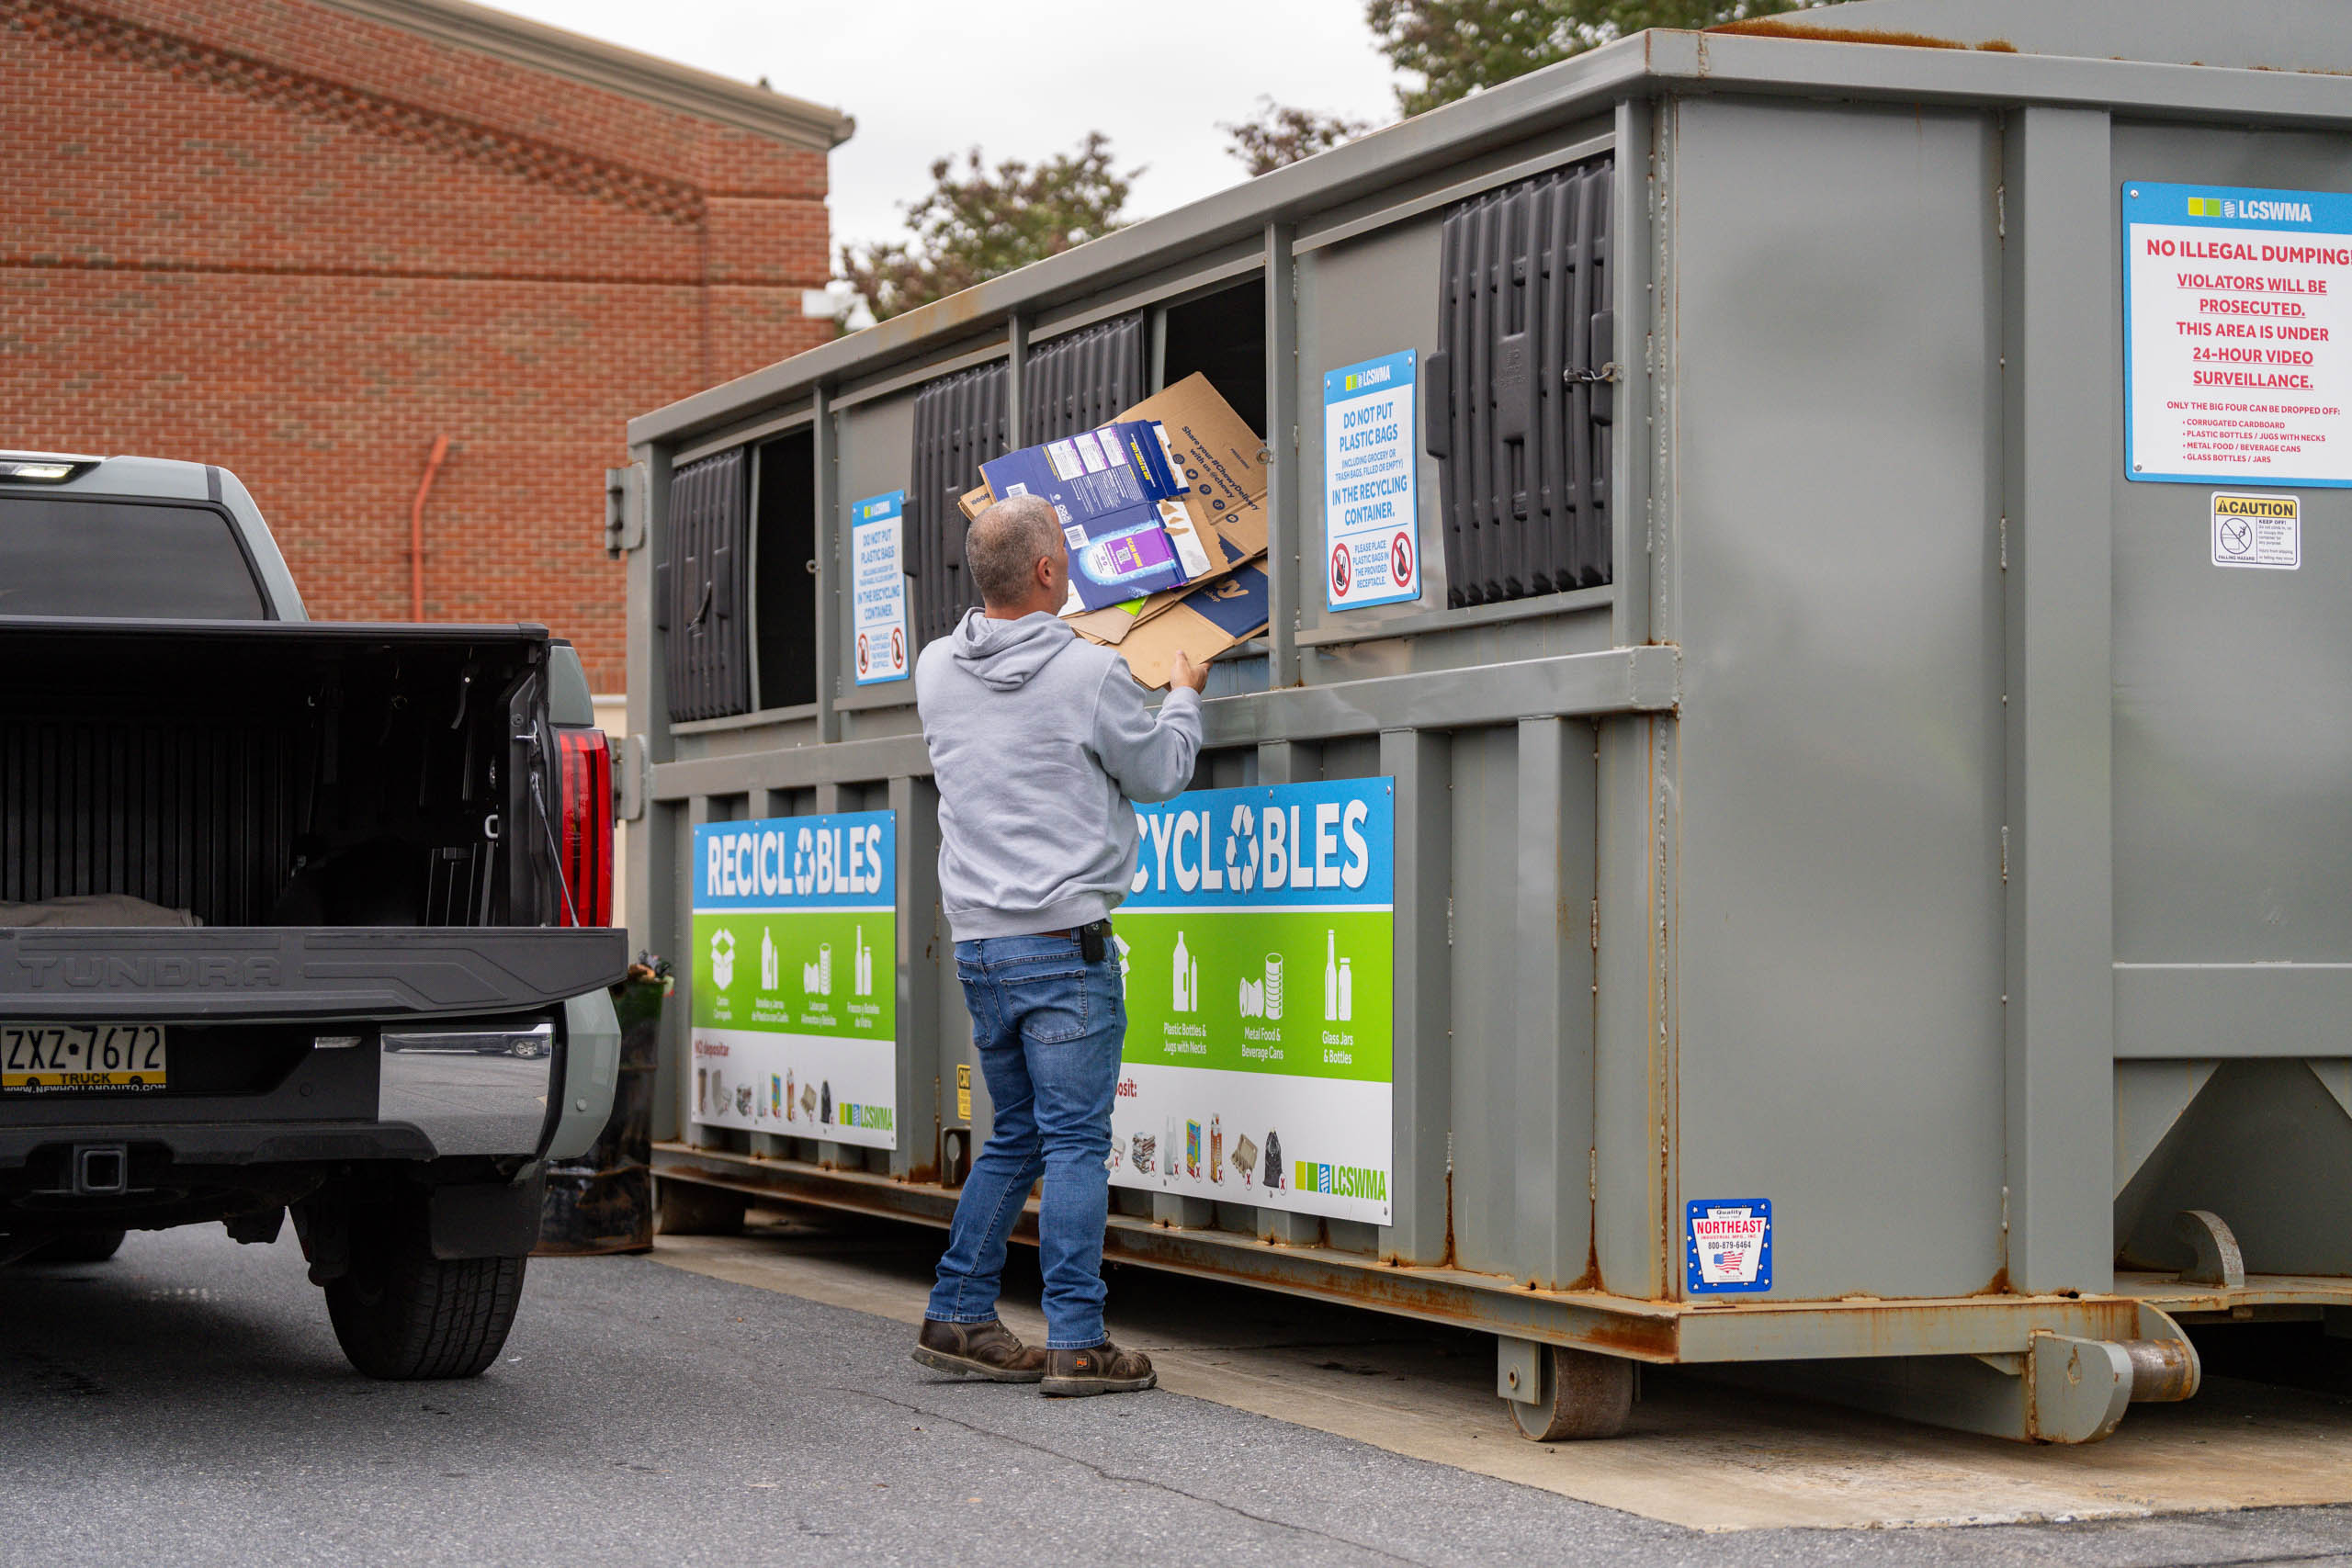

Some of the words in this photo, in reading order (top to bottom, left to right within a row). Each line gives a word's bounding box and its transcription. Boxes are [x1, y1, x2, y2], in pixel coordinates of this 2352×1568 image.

[2239, 200, 2312, 222] LCSWMA
[2147, 239, 2176, 257] NO
[2180, 241, 2257, 261] ILLEGAL
[2177, 273, 2264, 290] VIOLATORS
[2267, 277, 2304, 292] WILL
[2308, 279, 2327, 293] BE
[2199, 299, 2306, 316] PROSECUTED.
[2177, 321, 2212, 336] THIS
[2215, 323, 2256, 338] AREA
[2260, 325, 2274, 339] IS
[2277, 327, 2329, 342] UNDER
[2193, 347, 2262, 363] 24-HOUR
[2266, 350, 2313, 365] VIDEO
[1363, 366, 1391, 387] LCSWMA
[2193, 370, 2313, 389] SURVEILLANCE.
[1343, 411, 1356, 429] DO
[1357, 406, 1375, 426] NOT
[1376, 401, 1394, 421] PUT
[2166, 400, 2189, 410] ONLY
[2190, 402, 2208, 411] THE
[2209, 402, 2224, 412] BIG
[2225, 403, 2248, 412] FOUR
[2249, 404, 2267, 413] CAN
[2268, 405, 2280, 413] BE
[2281, 406, 2321, 415] DROPPED
[2322, 407, 2341, 416] OFF:
[2187, 419, 2237, 427] CORRUGATED
[2238, 420, 2286, 429] CARDBOARD
[1182, 425, 1200, 446] Share
[1196, 445, 1214, 460] your
[1340, 430, 1374, 453] PLASTIC
[1375, 423, 1398, 445] BAGS
[2187, 431, 2218, 439] PLASTIC
[2220, 432, 2253, 440] BOTTLES
[2258, 433, 2278, 441] JUGS
[2301, 434, 2326, 442] NECKS
[2187, 442, 2211, 450] METAL
[2212, 443, 2233, 451] FOOD
[2240, 444, 2279, 452] BEVERAGE
[2280, 445, 2301, 453] CANS
[1190, 448, 1204, 464] with
[1203, 463, 1211, 472] us
[1342, 455, 1367, 469] (INCLUDING
[1367, 449, 1388, 463] GROCERY
[1389, 448, 1396, 457] OR
[2212, 454, 2247, 462] BOTTLES
[2252, 455, 2271, 463] JARS
[1335, 471, 1351, 481] TRASH
[1363, 464, 1378, 476] FILLED
[1379, 463, 1385, 472] OR
[1332, 488, 1341, 506] IN
[1342, 485, 1358, 502] THE
[1360, 475, 1408, 501] RECYCLING
[1345, 502, 1395, 526] CONTAINER.
[2229, 502, 2293, 515] CAUTION
[1355, 543, 1371, 553] PLEASE
[1372, 540, 1386, 551] PLACE
[1352, 554, 1371, 566] PLASTIC
[1372, 553, 1384, 562] BAGS
[1355, 568, 1363, 577] THE
[1364, 564, 1387, 575] PROVIDED
[17, 956, 280, 987] TUNDRA
[1163, 1021, 1182, 1036] Plastic
[1182, 1023, 1202, 1037] Bottles
[1202, 1024, 1206, 1037] &
[1244, 1026, 1261, 1041] Metal
[1261, 1028, 1275, 1041] Food
[1276, 1028, 1281, 1042] &
[1163, 1040, 1177, 1055] Jugs
[1178, 1041, 1189, 1053] with
[1190, 1042, 1206, 1055] Necks
[1322, 1031, 1339, 1044] Glass
[1340, 1032, 1353, 1046] Jars
[1241, 1044, 1269, 1062] Beverage
[1269, 1046, 1283, 1060] Cans
[1323, 1049, 1329, 1063] &
[1329, 1050, 1352, 1065] Bottles
[60, 1073, 111, 1084] TRUCK
[860, 1103, 893, 1132] LCSWMA
[1331, 1164, 1387, 1201] LCSWMA
[1697, 1220, 1763, 1234] NORTHEAST
[1708, 1241, 1751, 1249] 800-879-6464
